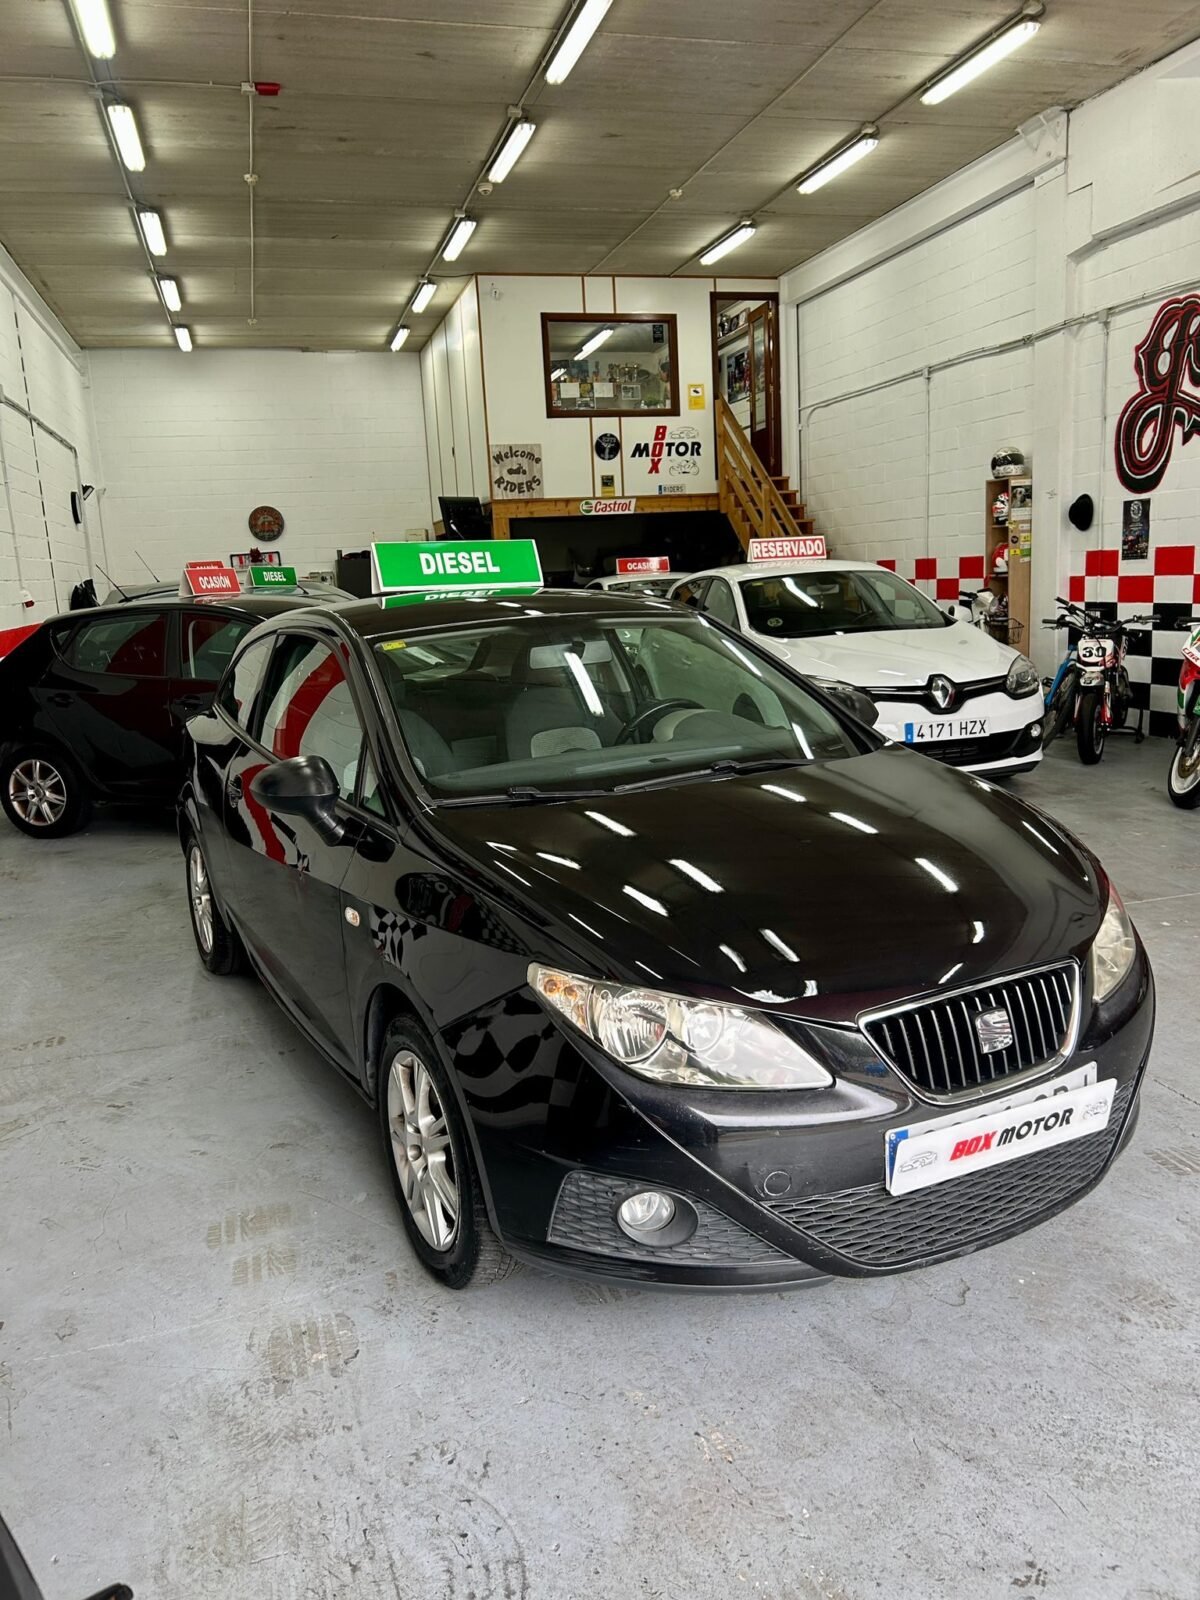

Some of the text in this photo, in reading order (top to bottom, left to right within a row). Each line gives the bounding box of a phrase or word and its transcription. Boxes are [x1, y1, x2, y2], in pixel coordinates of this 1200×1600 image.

[492, 445, 542, 465] Welcome
[494, 475, 541, 494] RIDERS
[594, 500, 632, 513] Castrol
[752, 540, 823, 558] RESERVADO
[419, 551, 500, 575] DIESEL
[198, 572, 232, 589] OCASIÓN
[262, 571, 287, 582] DIESEL
[917, 719, 987, 739] 4171 HZX
[950, 1107, 1074, 1161] BOX MOTOR
